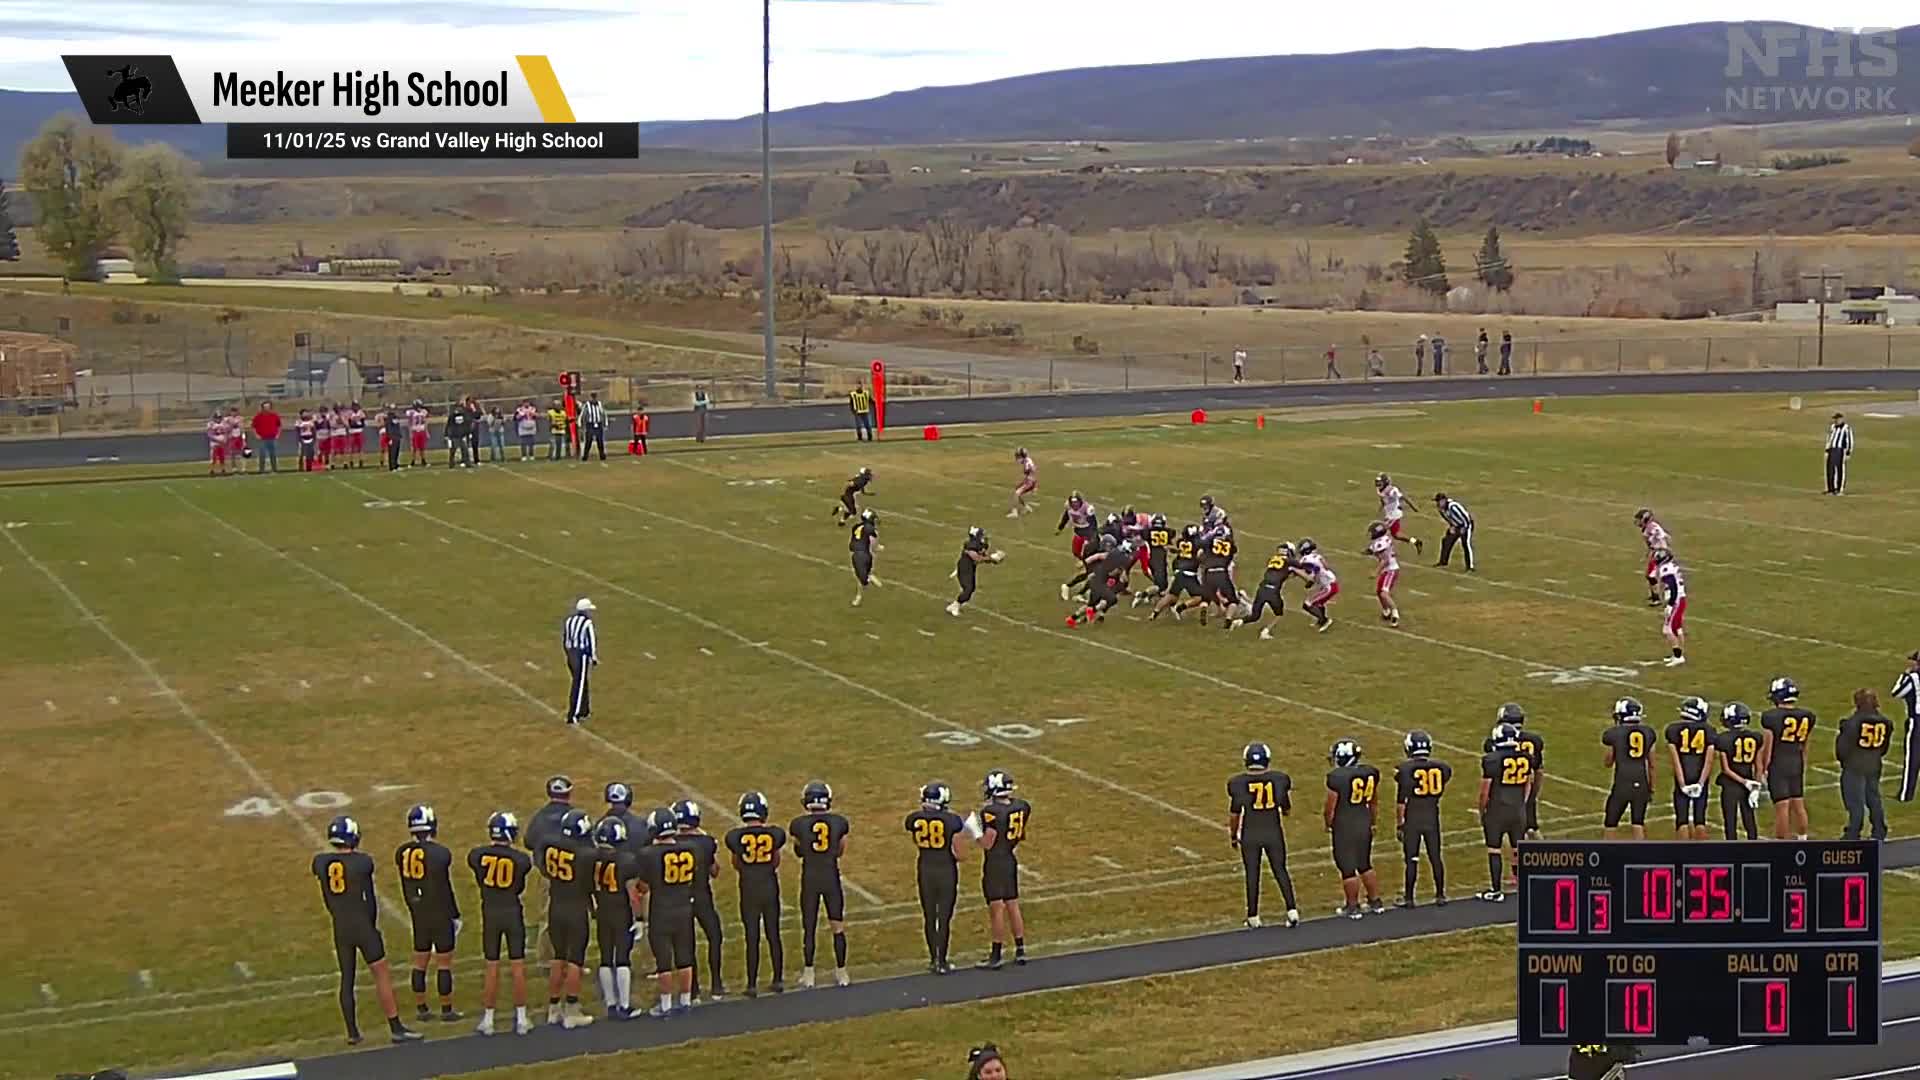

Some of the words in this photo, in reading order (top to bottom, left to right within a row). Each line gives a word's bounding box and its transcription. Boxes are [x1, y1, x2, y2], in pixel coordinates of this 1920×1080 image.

[1150, 530, 1168, 546] 59
[1212, 539, 1231, 557] 53
[922, 723, 1044, 745] 30
[1680, 728, 1705, 754] 14
[1781, 717, 1809, 742] 24
[1859, 723, 1886, 748] 50
[1629, 731, 1644, 758] 9
[1733, 737, 1756, 763] 19
[1414, 767, 1442, 795] 30
[1502, 757, 1529, 784] 22
[1248, 782, 1276, 809] 71
[1350, 775, 1374, 804] 64
[224, 791, 352, 816] 40
[812, 822, 829, 852] 3
[914, 819, 945, 848] 28
[1007, 811, 1024, 840] 51
[741, 834, 773, 863] 32
[402, 848, 425, 879] 16
[481, 855, 513, 888] 70
[545, 847, 575, 881] 65
[664, 851, 694, 883] 62
[328, 862, 345, 893] 8
